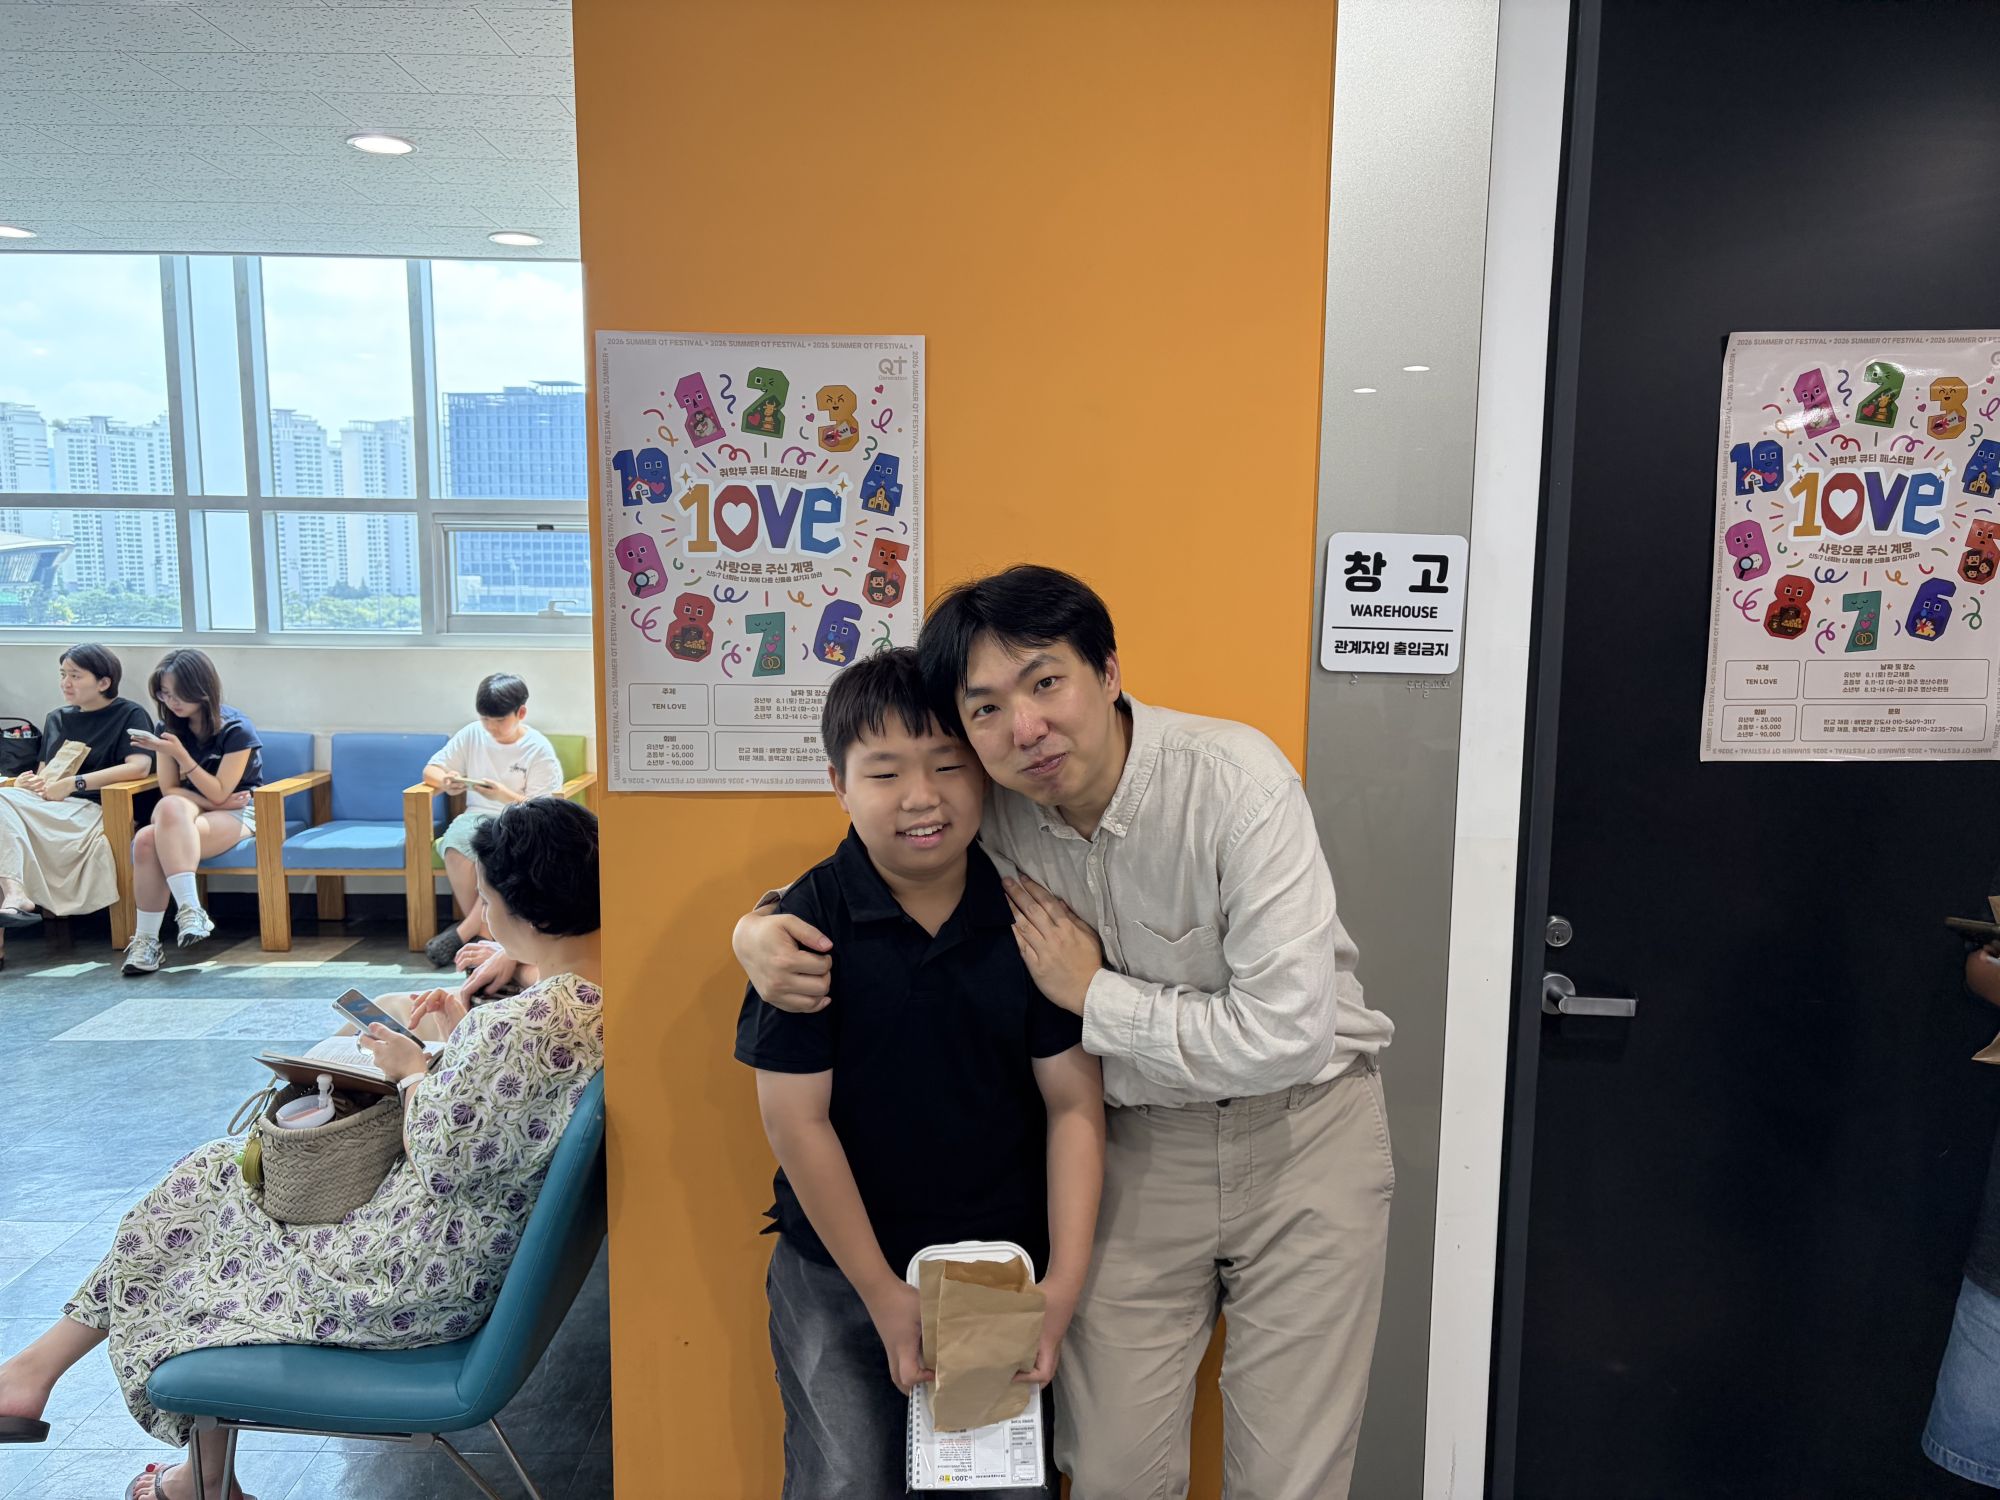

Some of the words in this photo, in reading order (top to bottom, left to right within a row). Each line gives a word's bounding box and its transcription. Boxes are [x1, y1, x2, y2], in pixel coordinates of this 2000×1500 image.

[878, 356, 908, 376] QT
[912, 403, 919, 412] QT
[605, 446, 611, 455] QT
[1830, 455, 1857, 466] 취학부
[1859, 454, 1877, 463] 큐티
[1880, 454, 1914, 465] 페스티벌
[719, 466, 747, 478] 취학부
[750, 466, 768, 475] 큐티
[771, 466, 808, 479] 페스티벌
[912, 506, 919, 516] QT
[608, 548, 614, 558] QT
[1818, 543, 1863, 556] 사랑으로
[1866, 544, 1887, 555] 주신
[1891, 542, 1913, 554] 계명
[715, 560, 762, 574] 사랑으로
[766, 563, 787, 574] 주신
[791, 560, 814, 573] 계명
[1344, 551, 1387, 592] 창
[1408, 554, 1448, 593] 고
[912, 608, 919, 617] QT
[1350, 604, 1438, 618] WAREHOUSE
[611, 648, 618, 656] QT
[1334, 640, 1389, 655] 관계자외
[1394, 642, 1448, 656] 출입금지
[613, 745, 620, 754] QT
